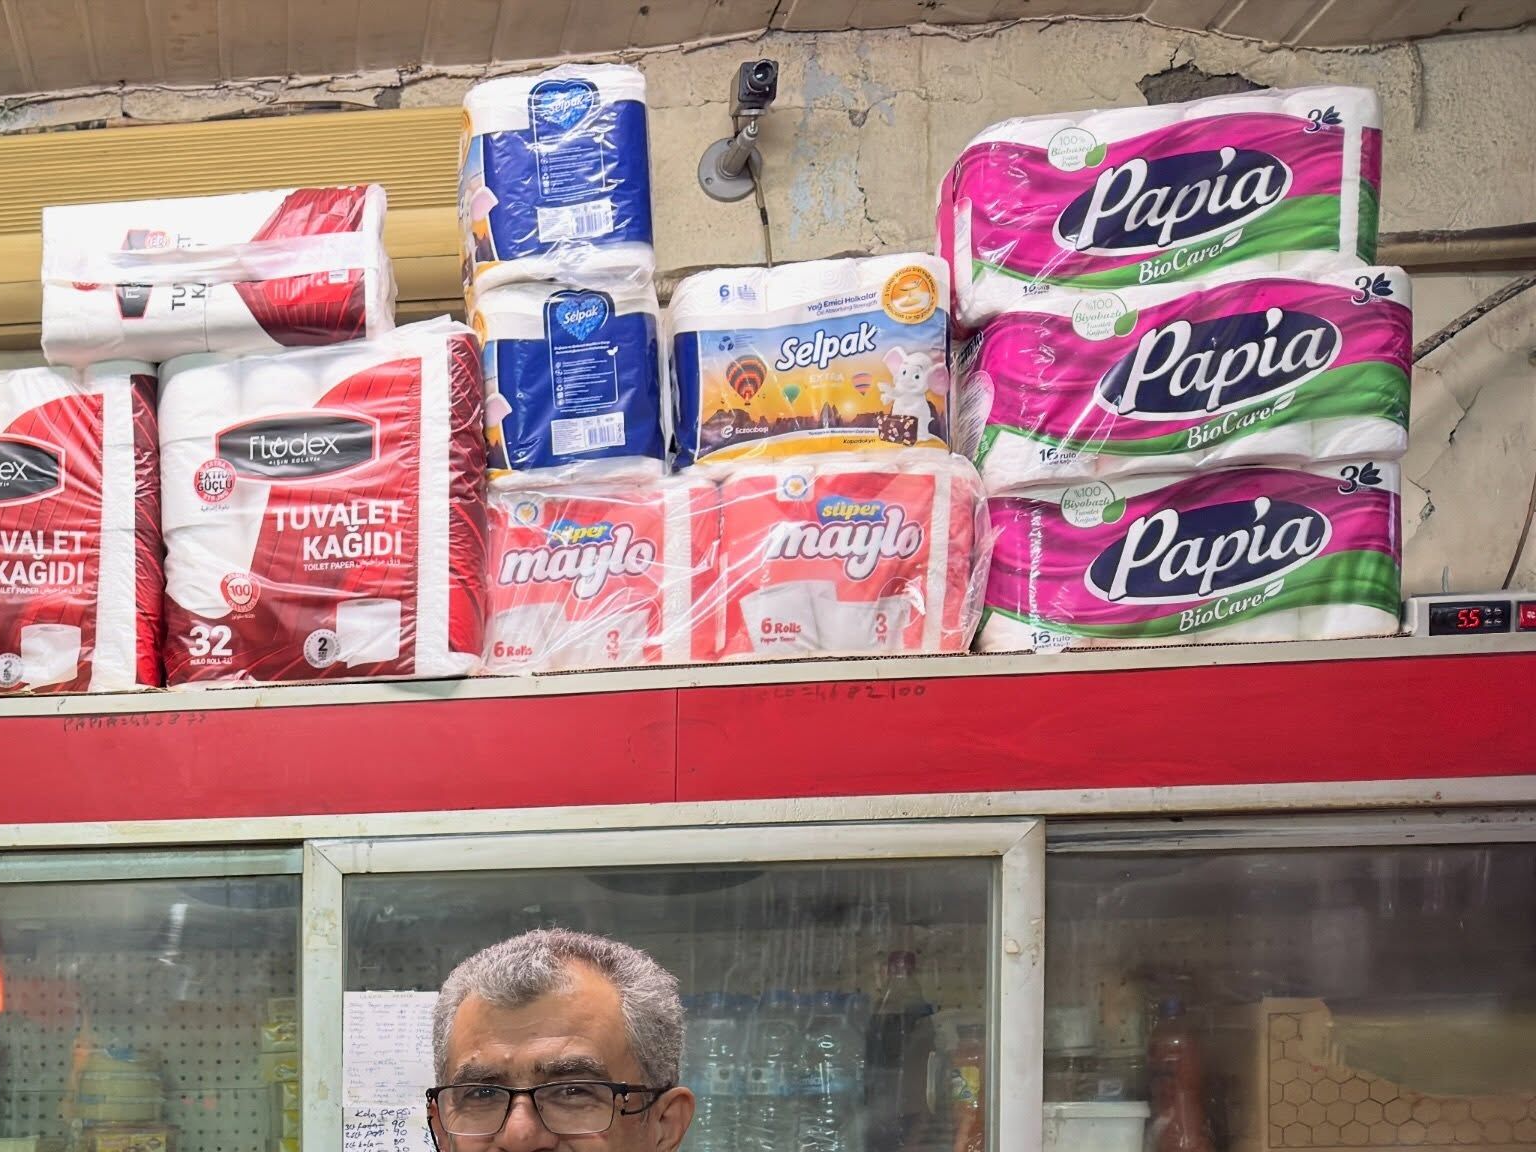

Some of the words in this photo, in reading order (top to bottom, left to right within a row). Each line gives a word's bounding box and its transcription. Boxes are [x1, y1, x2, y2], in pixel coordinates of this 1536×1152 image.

[1304, 108, 1322, 133] 3
[1075, 146, 1277, 250] Papia
[1139, 245, 1224, 285] BioCare
[719, 285, 730, 298] 6
[1351, 275, 1371, 305] 3
[564, 306, 598, 324] Selpak
[808, 302, 822, 312] Yağ
[823, 298, 844, 309] Emici
[776, 322, 877, 371] Selpak
[1118, 307, 1328, 415] Papia
[1187, 408, 1273, 449] BioCare
[249, 433, 340, 460] Flodex
[1338, 466, 1359, 495] 3
[272, 500, 404, 532] TUVALET
[822, 502, 880, 520] süper
[303, 525, 402, 561] KAĞIDI
[766, 505, 923, 581] maylo
[1108, 496, 1314, 601] Papia
[304, 563, 329, 572] TOILET
[331, 561, 355, 569] PAPER
[498, 523, 655, 600] maylo
[230, 584, 249, 596] 100
[761, 618, 772, 634] 6
[775, 622, 801, 633] Rolls
[875, 613, 887, 634] 3
[1179, 594, 1263, 632] BioCare
[189, 625, 233, 656] 32
[318, 638, 328, 651] 2
[494, 641, 504, 657] 6
[4, 660, 12, 672] 2
